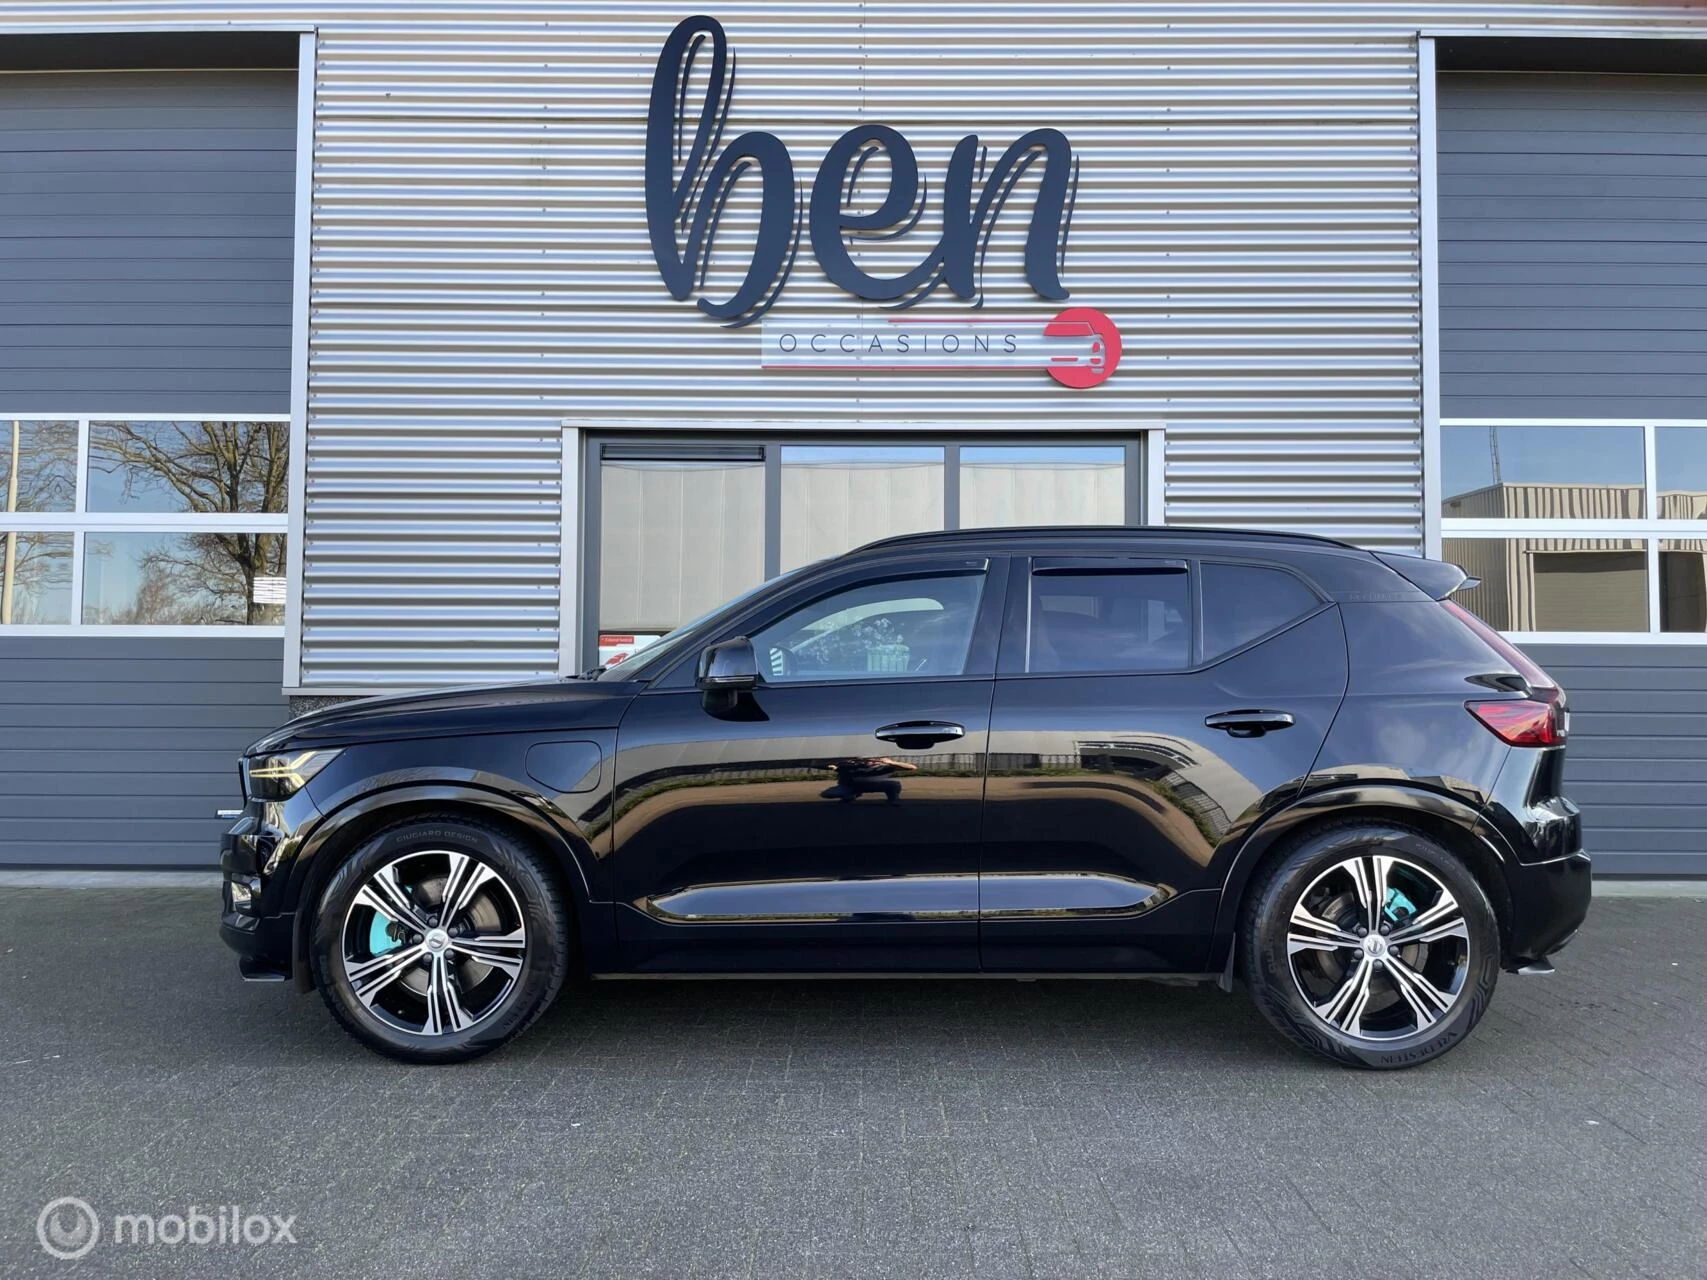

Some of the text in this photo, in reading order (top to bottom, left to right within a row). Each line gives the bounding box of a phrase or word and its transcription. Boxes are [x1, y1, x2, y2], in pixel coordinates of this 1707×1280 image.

[645, 15, 1079, 327] ben
[779, 333, 1018, 354] OCCASIONS
[444, 831, 478, 844] DESIGN
